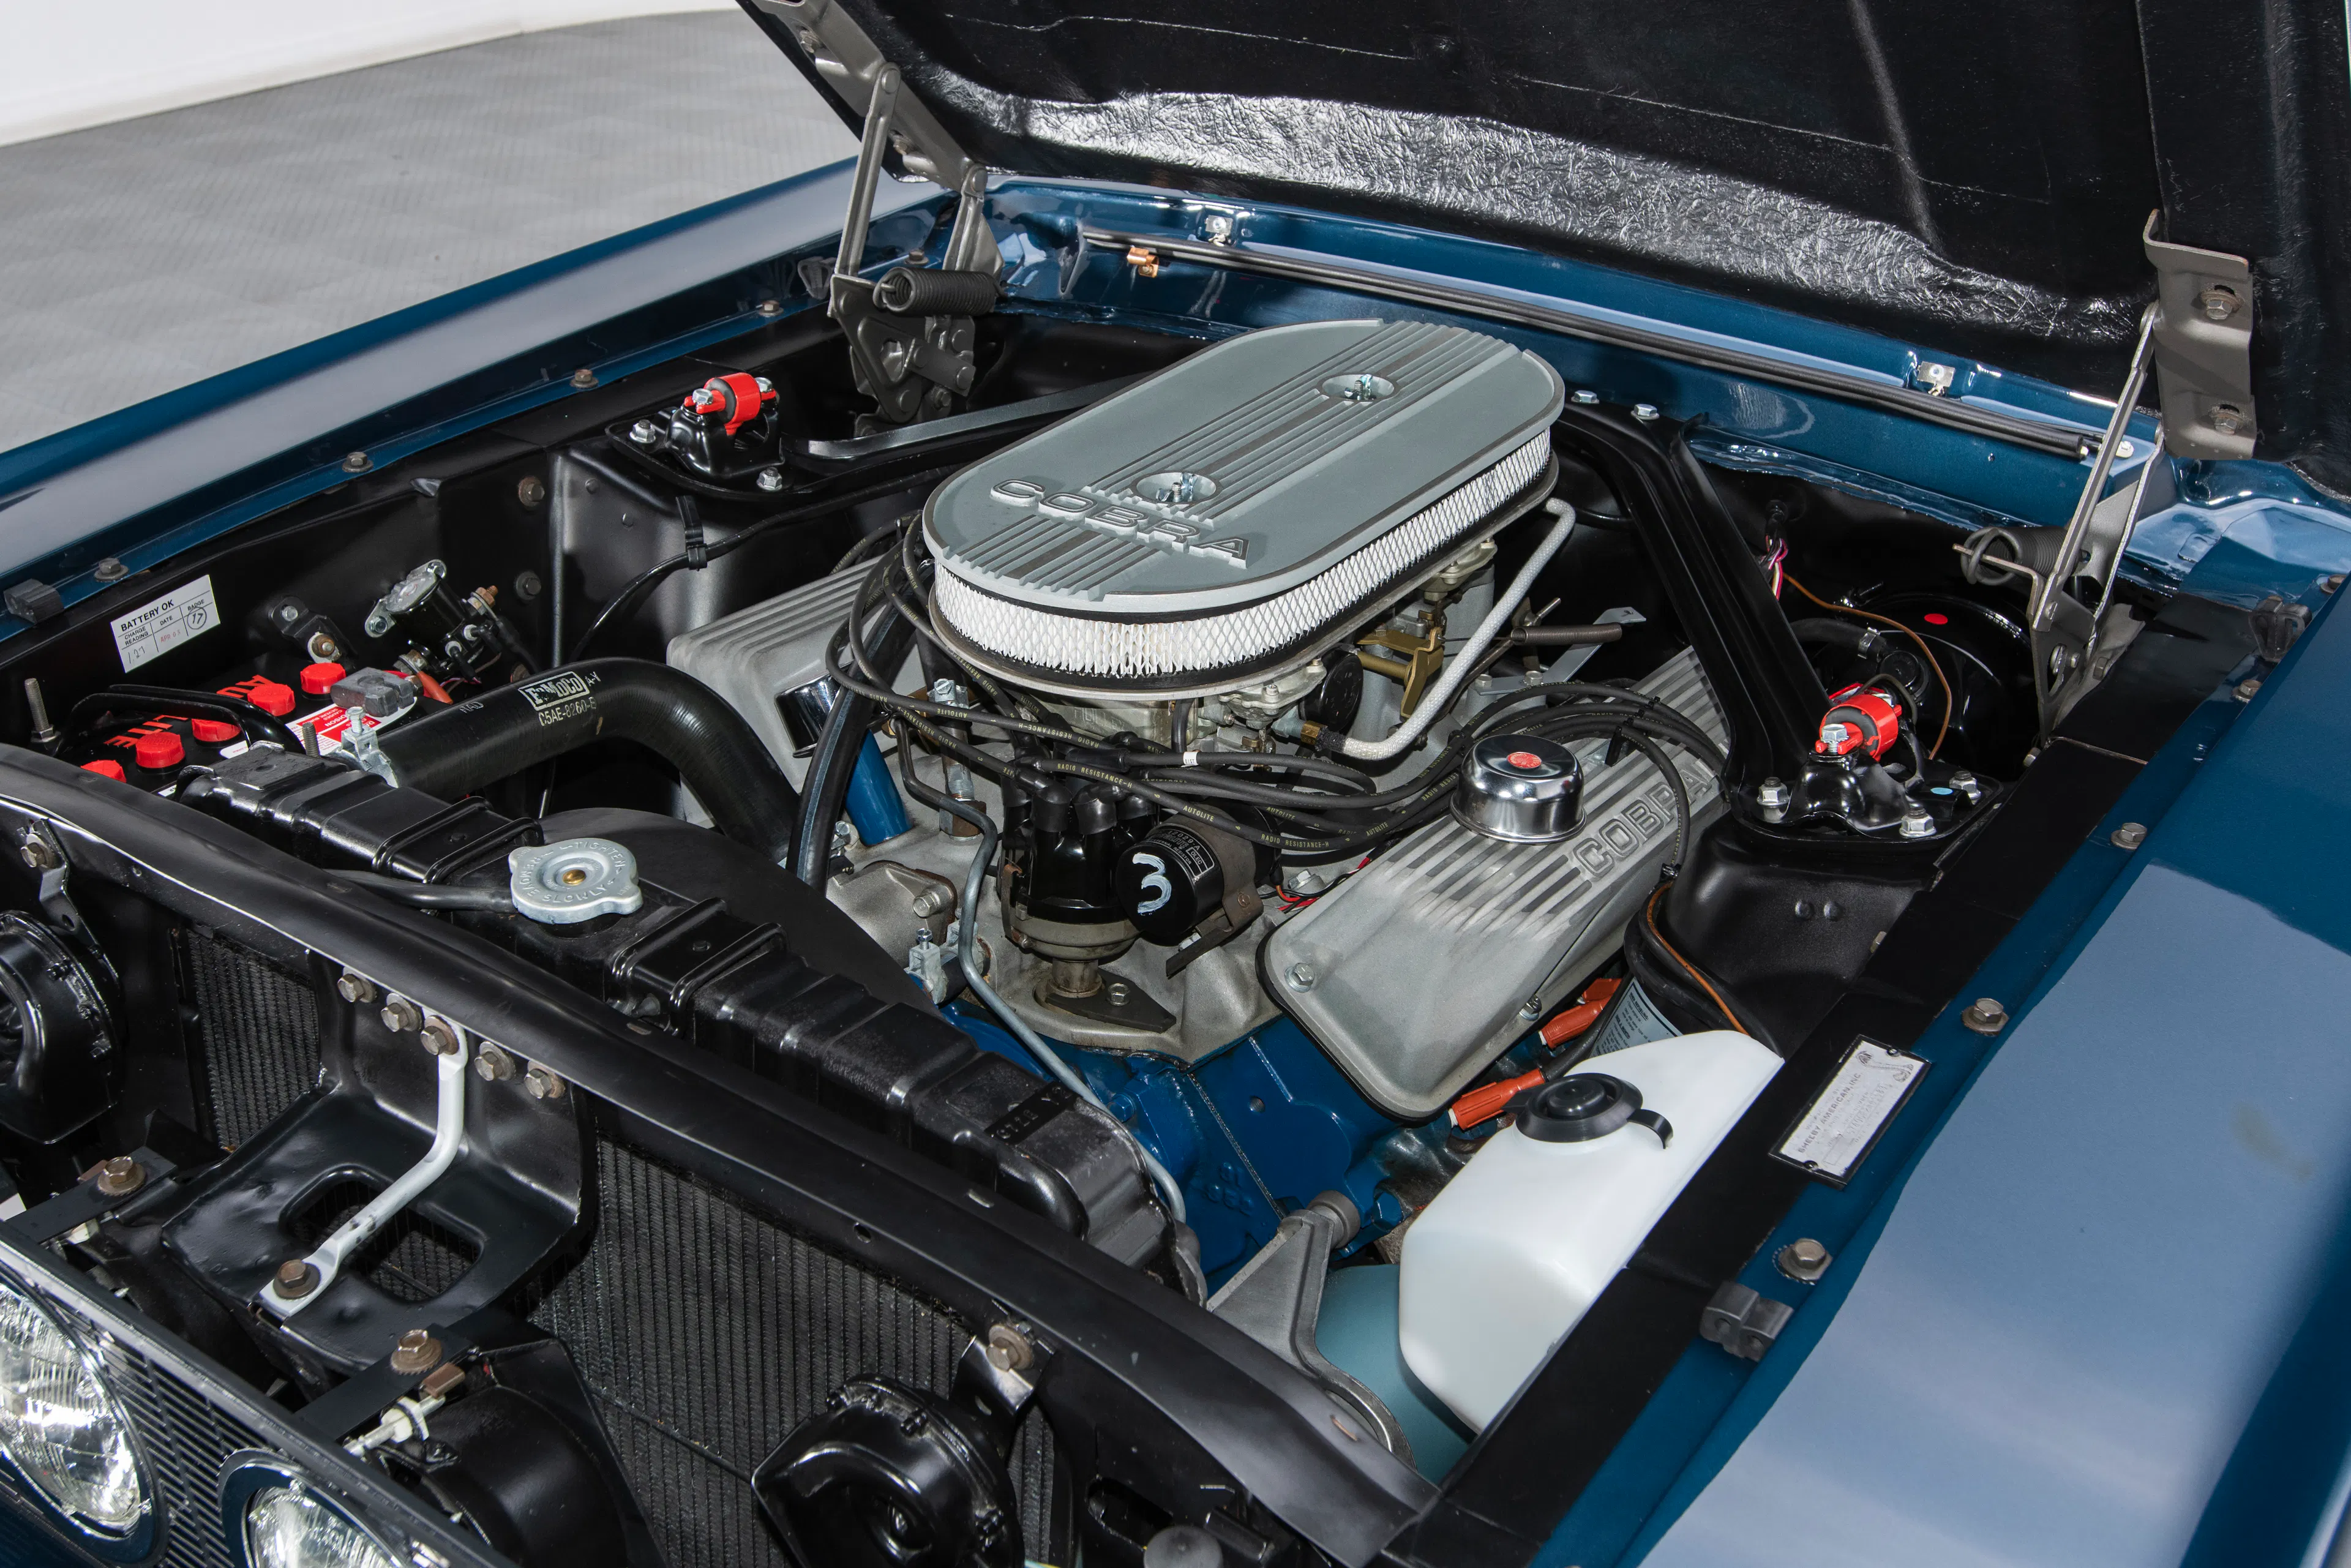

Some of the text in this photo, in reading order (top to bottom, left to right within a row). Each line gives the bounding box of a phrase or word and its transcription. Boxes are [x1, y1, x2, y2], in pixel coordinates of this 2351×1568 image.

[990, 479, 1250, 569] COBRA
[187, 599, 204, 610] BADGE
[121, 599, 174, 632] BATTERY OK
[160, 616, 173, 626] DATE
[192, 613, 203, 624] 17
[125, 626, 146, 640] CHARGE
[125, 631, 148, 646] READING
[160, 633, 170, 642] APR
[983, 680, 998, 696] RADIO
[869, 693, 887, 702] RADIO
[538, 697, 596, 726] C5AE-8260-E
[937, 708, 967, 718] AUTOLITE
[324, 715, 348, 727] OISON
[897, 706, 956, 749] RADIO RESISTANCE-H
[1019, 722, 1099, 748] RADIO RESISTANCE-H
[1081, 767, 1133, 789] RESISTANCE-H
[1421, 787, 1438, 801] RADIO
[1266, 806, 1295, 820] AUTOLITE
[1183, 805, 1215, 822] AUTOLITE
[1261, 834, 1280, 844] RADIO
[1285, 839, 1329, 848] RESISTANCE-H
[1366, 822, 1389, 837] AUTOLITE
[574, 842, 626, 868] TIGHTEN
[1173, 847, 1192, 865] RESISTOR
[519, 857, 541, 896] REMOVE
[1133, 852, 1172, 913] 3
[542, 884, 607, 903] SLOWLY
[1798, 1125, 1821, 1153] SHELBY
